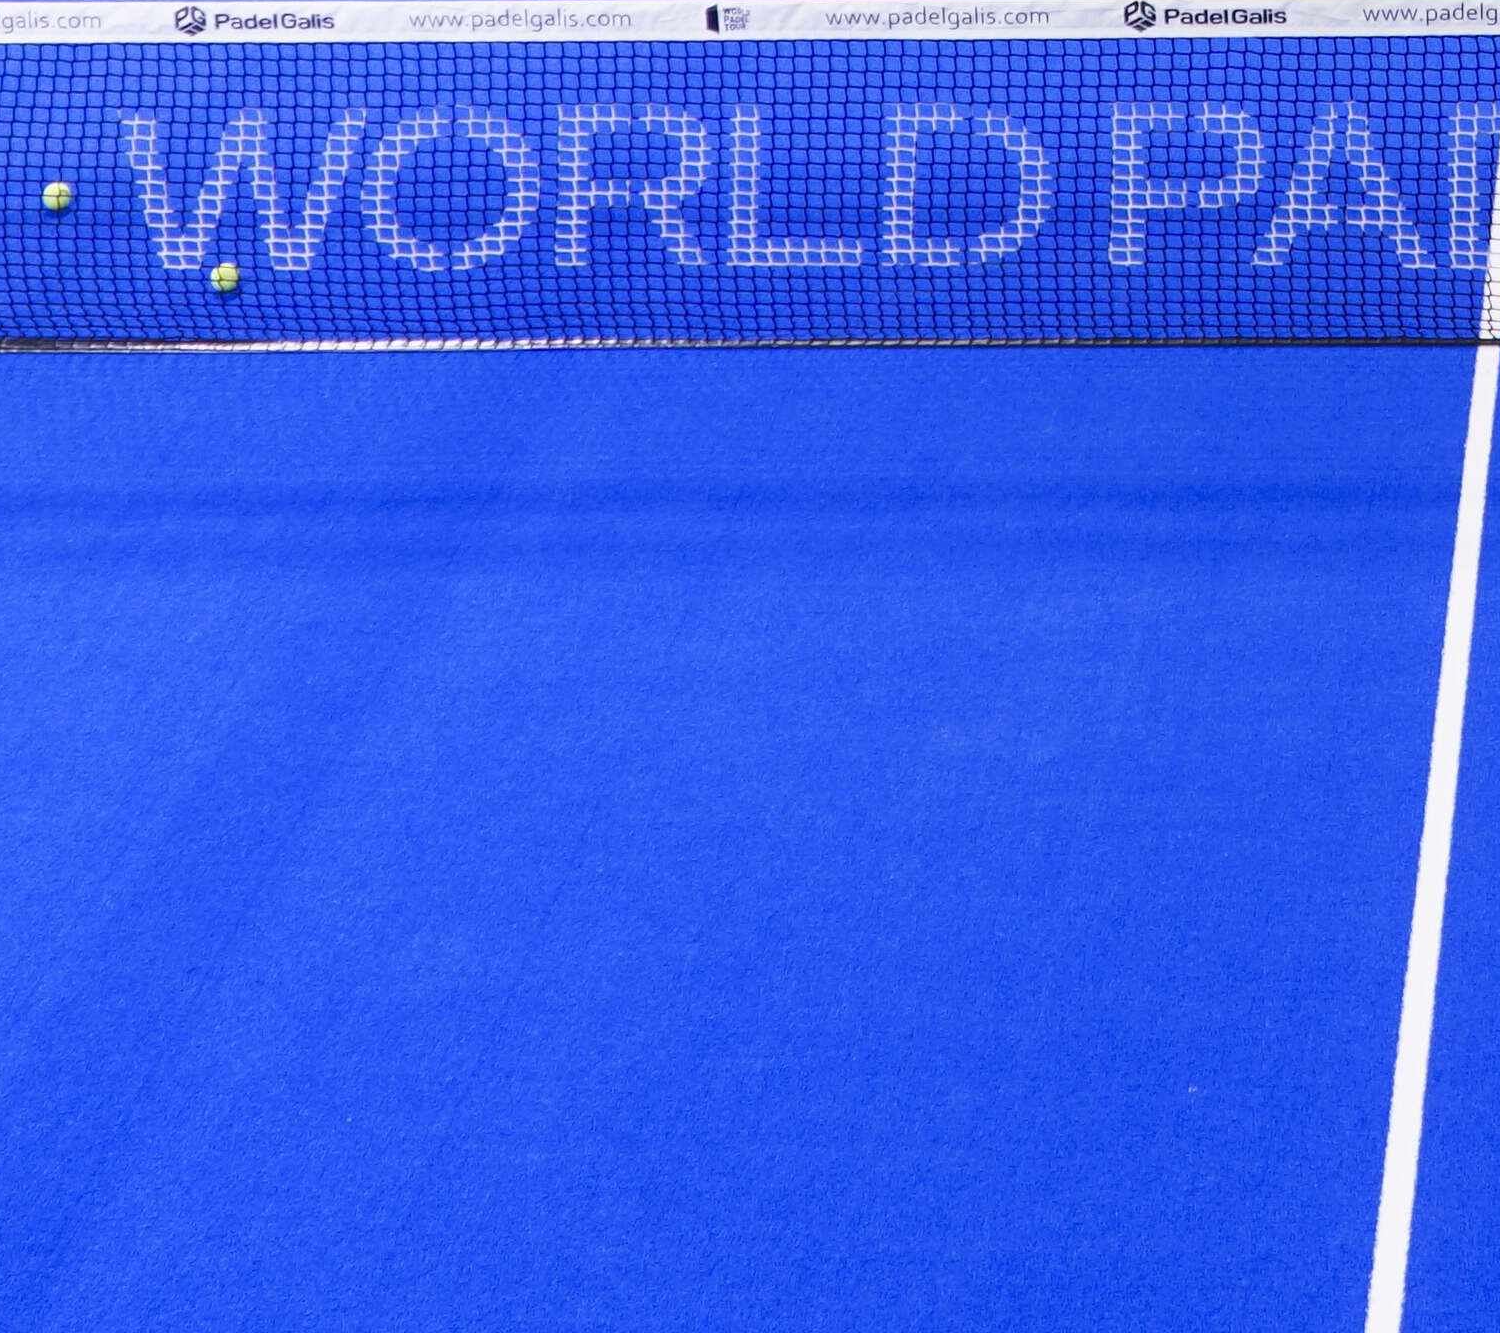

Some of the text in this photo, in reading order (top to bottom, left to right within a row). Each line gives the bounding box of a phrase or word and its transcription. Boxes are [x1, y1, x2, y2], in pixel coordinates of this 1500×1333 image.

[408, 8, 631, 32] www.padelgalis.com
[826, 6, 1049, 29] www.padelgalis.com
[119, 102, 1059, 270] WORLD
